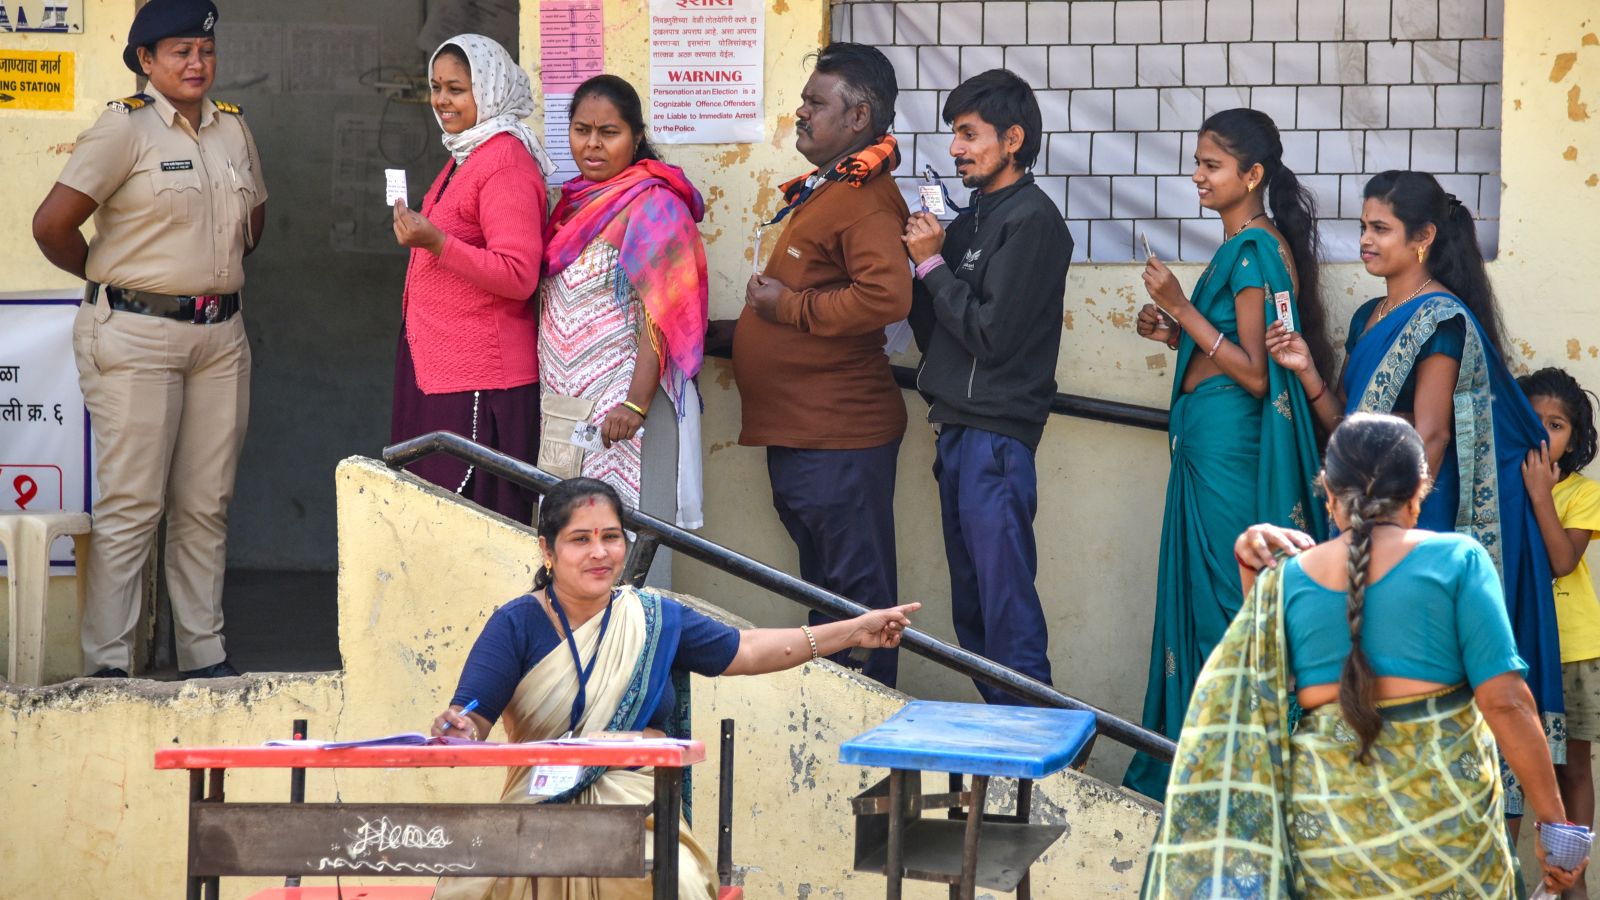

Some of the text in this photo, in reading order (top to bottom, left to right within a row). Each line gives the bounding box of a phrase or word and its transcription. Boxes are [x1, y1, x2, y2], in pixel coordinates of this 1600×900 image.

[750, 16, 757, 24] हा
[40, 54, 62, 74] मार्ग
[667, 70, 743, 82] WARNING
[19, 81, 61, 93] STATION
[653, 100, 691, 108] Cognizable
[723, 99, 756, 107] Offenders
[653, 125, 662, 133] by
[674, 124, 696, 132] Police.
[53, 403, 64, 426] ६
